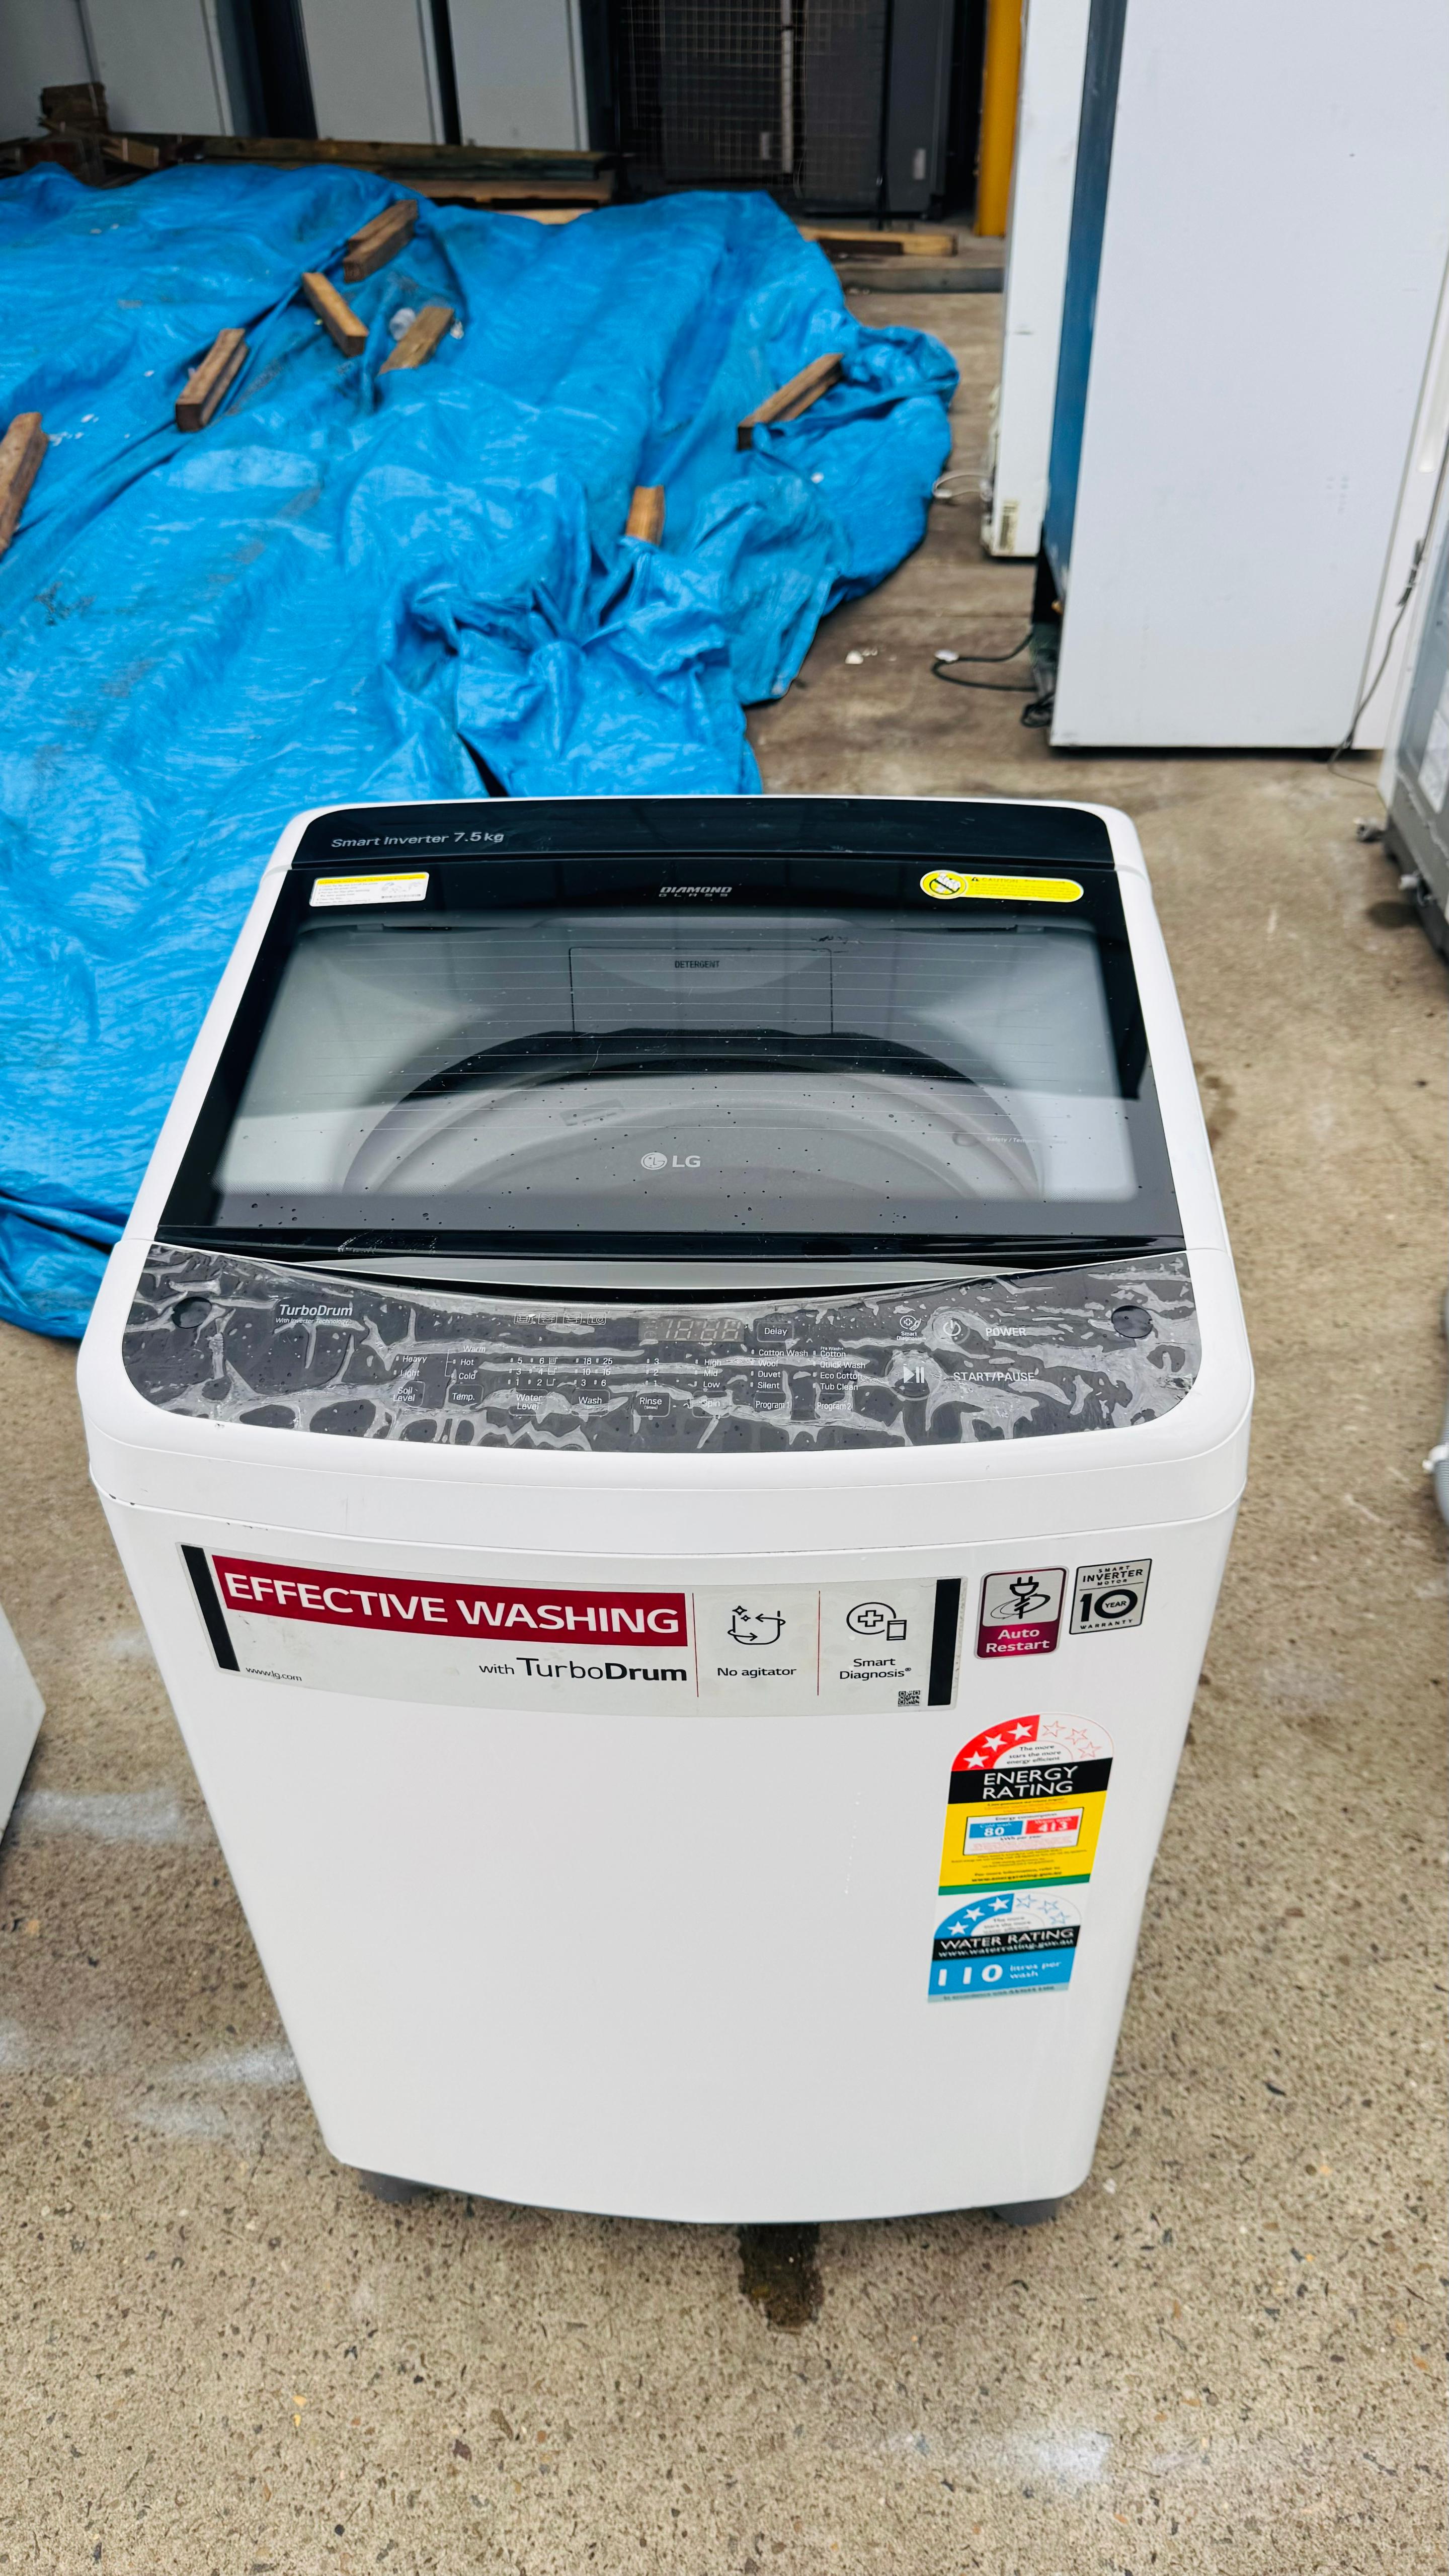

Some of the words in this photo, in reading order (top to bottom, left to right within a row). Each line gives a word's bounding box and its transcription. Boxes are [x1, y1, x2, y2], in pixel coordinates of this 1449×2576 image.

[331, 837, 380, 847] Smart
[384, 834, 449, 845] Inverter
[675, 960, 720, 968] DETERGENT
[672, 1155, 701, 1168] LG
[280, 1304, 353, 1316] TurboDrum
[764, 1328, 788, 1336] Delay
[985, 1327, 1026, 1337] POWER
[403, 1355, 427, 1364] Heavy
[704, 1359, 721, 1367] High
[459, 1371, 476, 1380] Cold
[953, 1372, 1034, 1382] START/PAUSE
[516, 1394, 542, 1402] Water
[579, 1396, 602, 1404] Wash
[639, 1397, 663, 1405] Rinse
[755, 1401, 785, 1410] Program
[817, 1402, 847, 1411] Program
[1082, 1569, 1144, 1582] INVERTER
[224, 1572, 448, 1623] EFFECTIVE
[455, 1599, 679, 1634] WASHING
[1080, 1589, 1138, 1622] 10
[1080, 1619, 1133, 1630] WARRANTY
[998, 1629, 1040, 1640] Auto
[986, 1639, 1051, 1653] Restart
[853, 1658, 896, 1667] Smart
[246, 1667, 302, 1681] www.lg.com
[479, 1664, 515, 1675] with
[516, 1657, 687, 1681] TurboDrum
[717, 1667, 738, 1676] No
[742, 1667, 797, 1679] agitator
[984, 1765, 1079, 1786] ENERGY
[983, 1781, 1074, 1800] RATING
[984, 1827, 1005, 1836] 80
[1038, 1821, 1069, 1832] 413
[940, 1936, 1002, 1950] WATER
[1007, 1927, 1075, 1945] RATING
[938, 1964, 1004, 1987] 110
